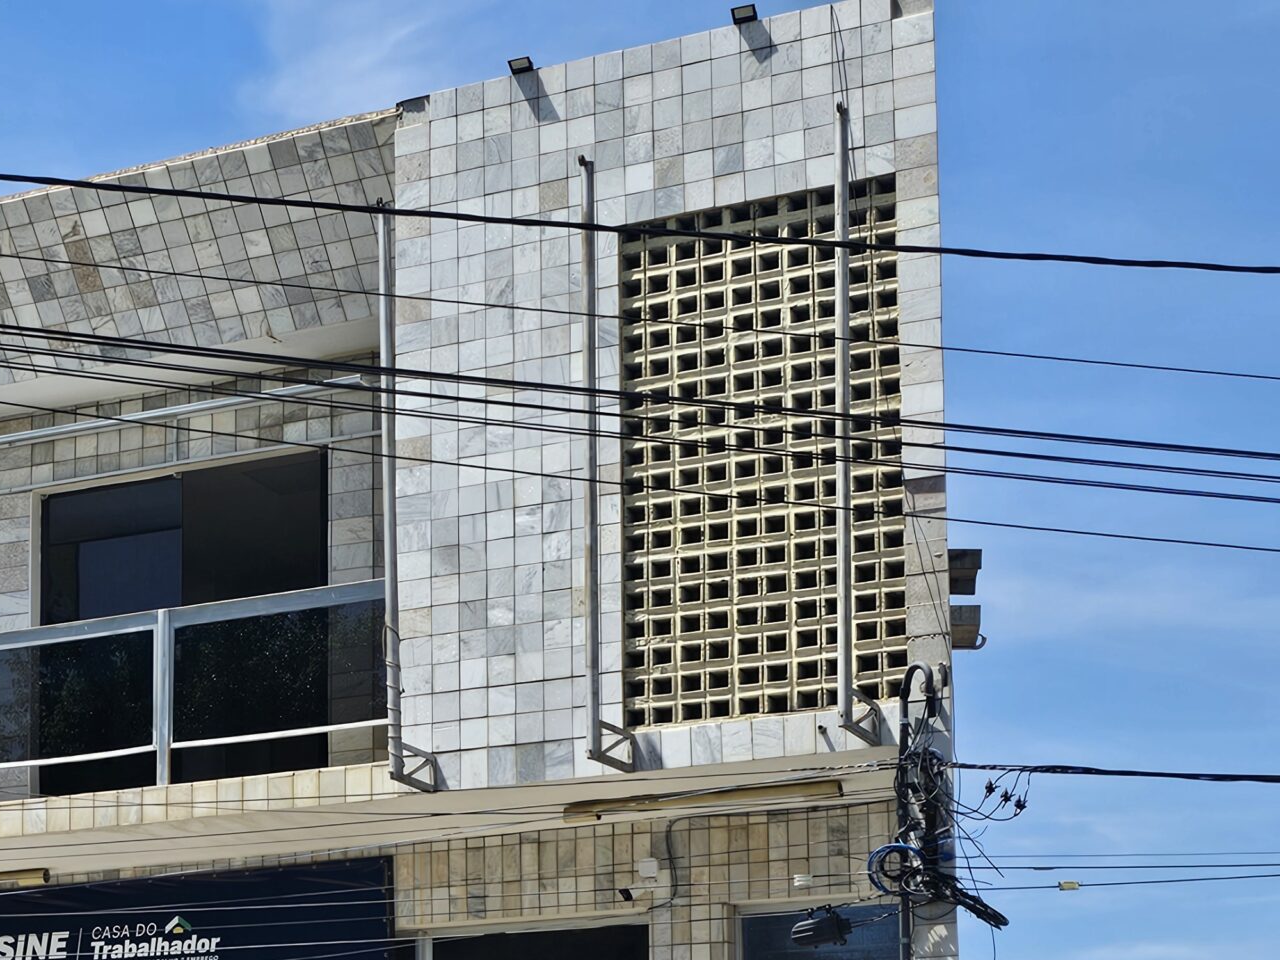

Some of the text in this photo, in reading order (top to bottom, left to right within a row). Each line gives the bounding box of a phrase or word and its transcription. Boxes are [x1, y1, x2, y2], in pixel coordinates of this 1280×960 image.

[91, 922, 157, 940] CASA DO
[90, 934, 221, 960] Trabalhador
